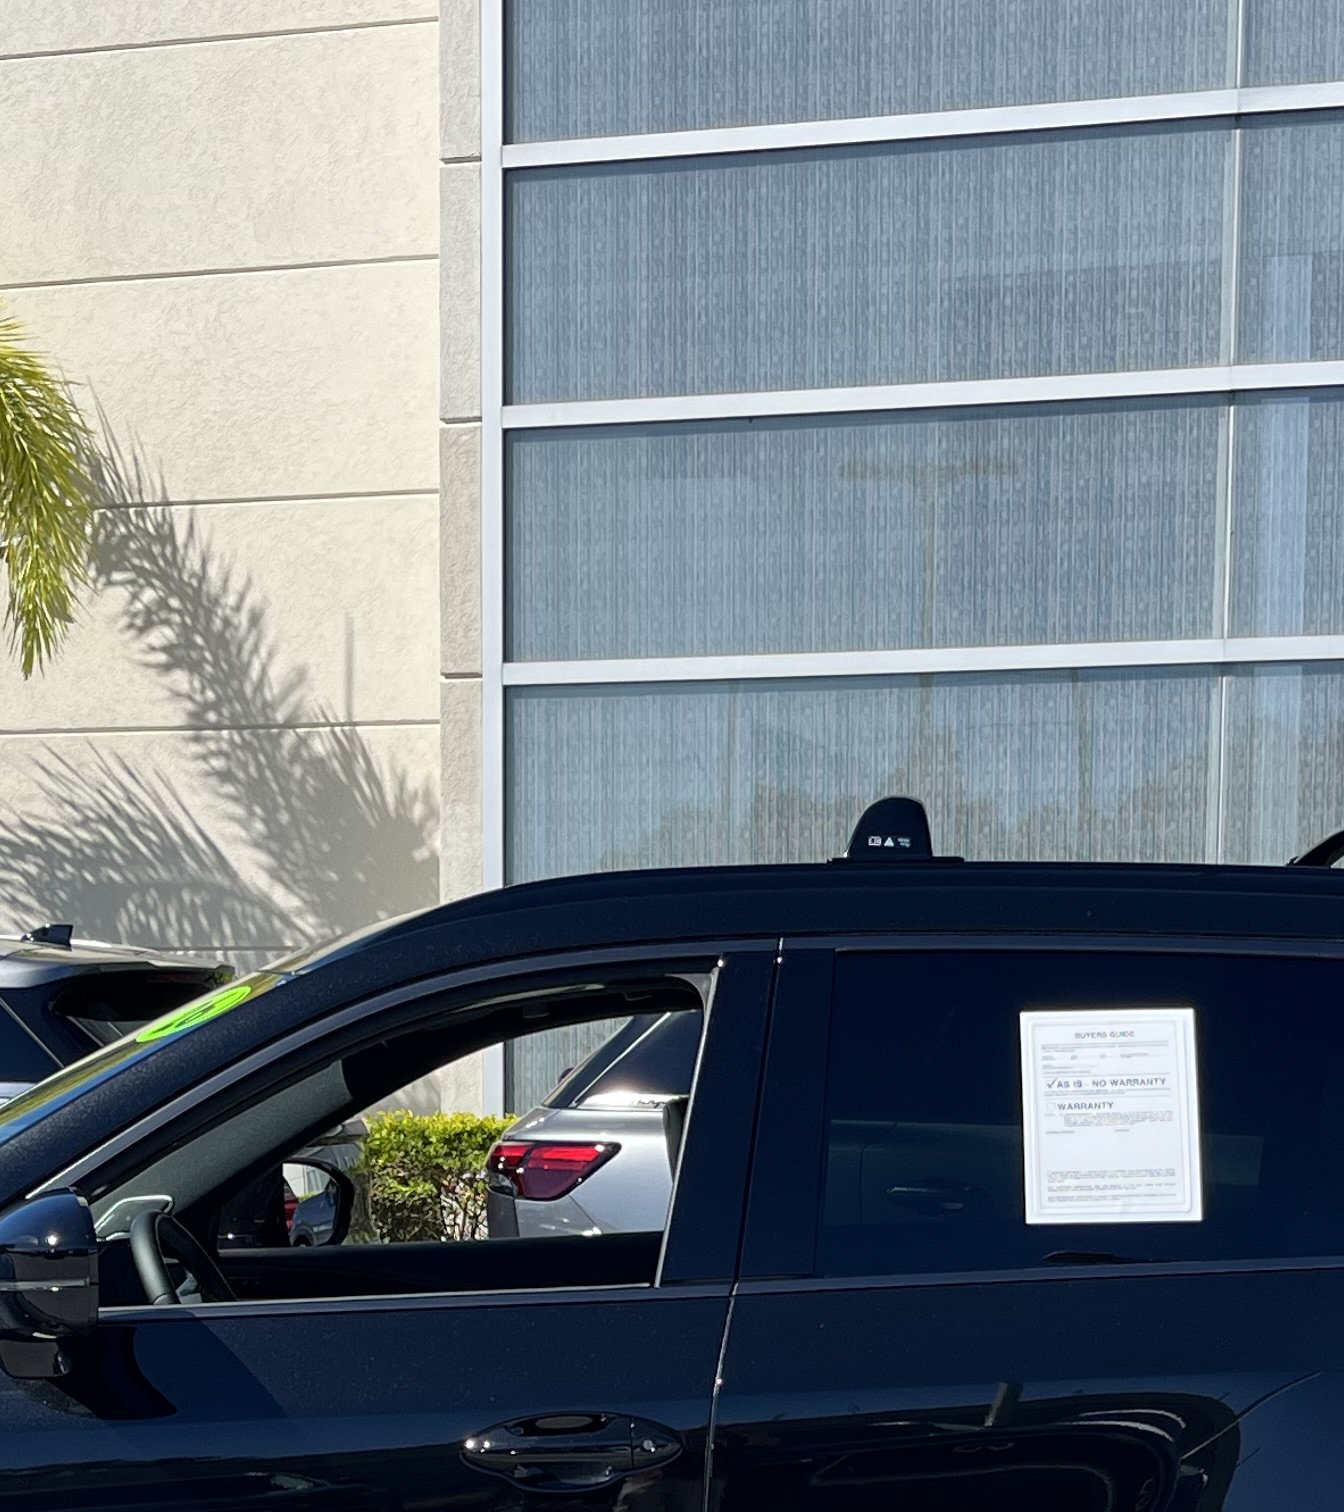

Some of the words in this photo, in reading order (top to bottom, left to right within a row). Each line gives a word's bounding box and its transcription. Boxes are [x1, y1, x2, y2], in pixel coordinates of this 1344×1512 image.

[1057, 1080, 1070, 1088] AS
[1073, 1079, 1083, 1088] IS
[1092, 1079, 1106, 1087] NO
[1110, 1077, 1166, 1087] WARRANTY
[1057, 1101, 1114, 1111] WARRANTY
